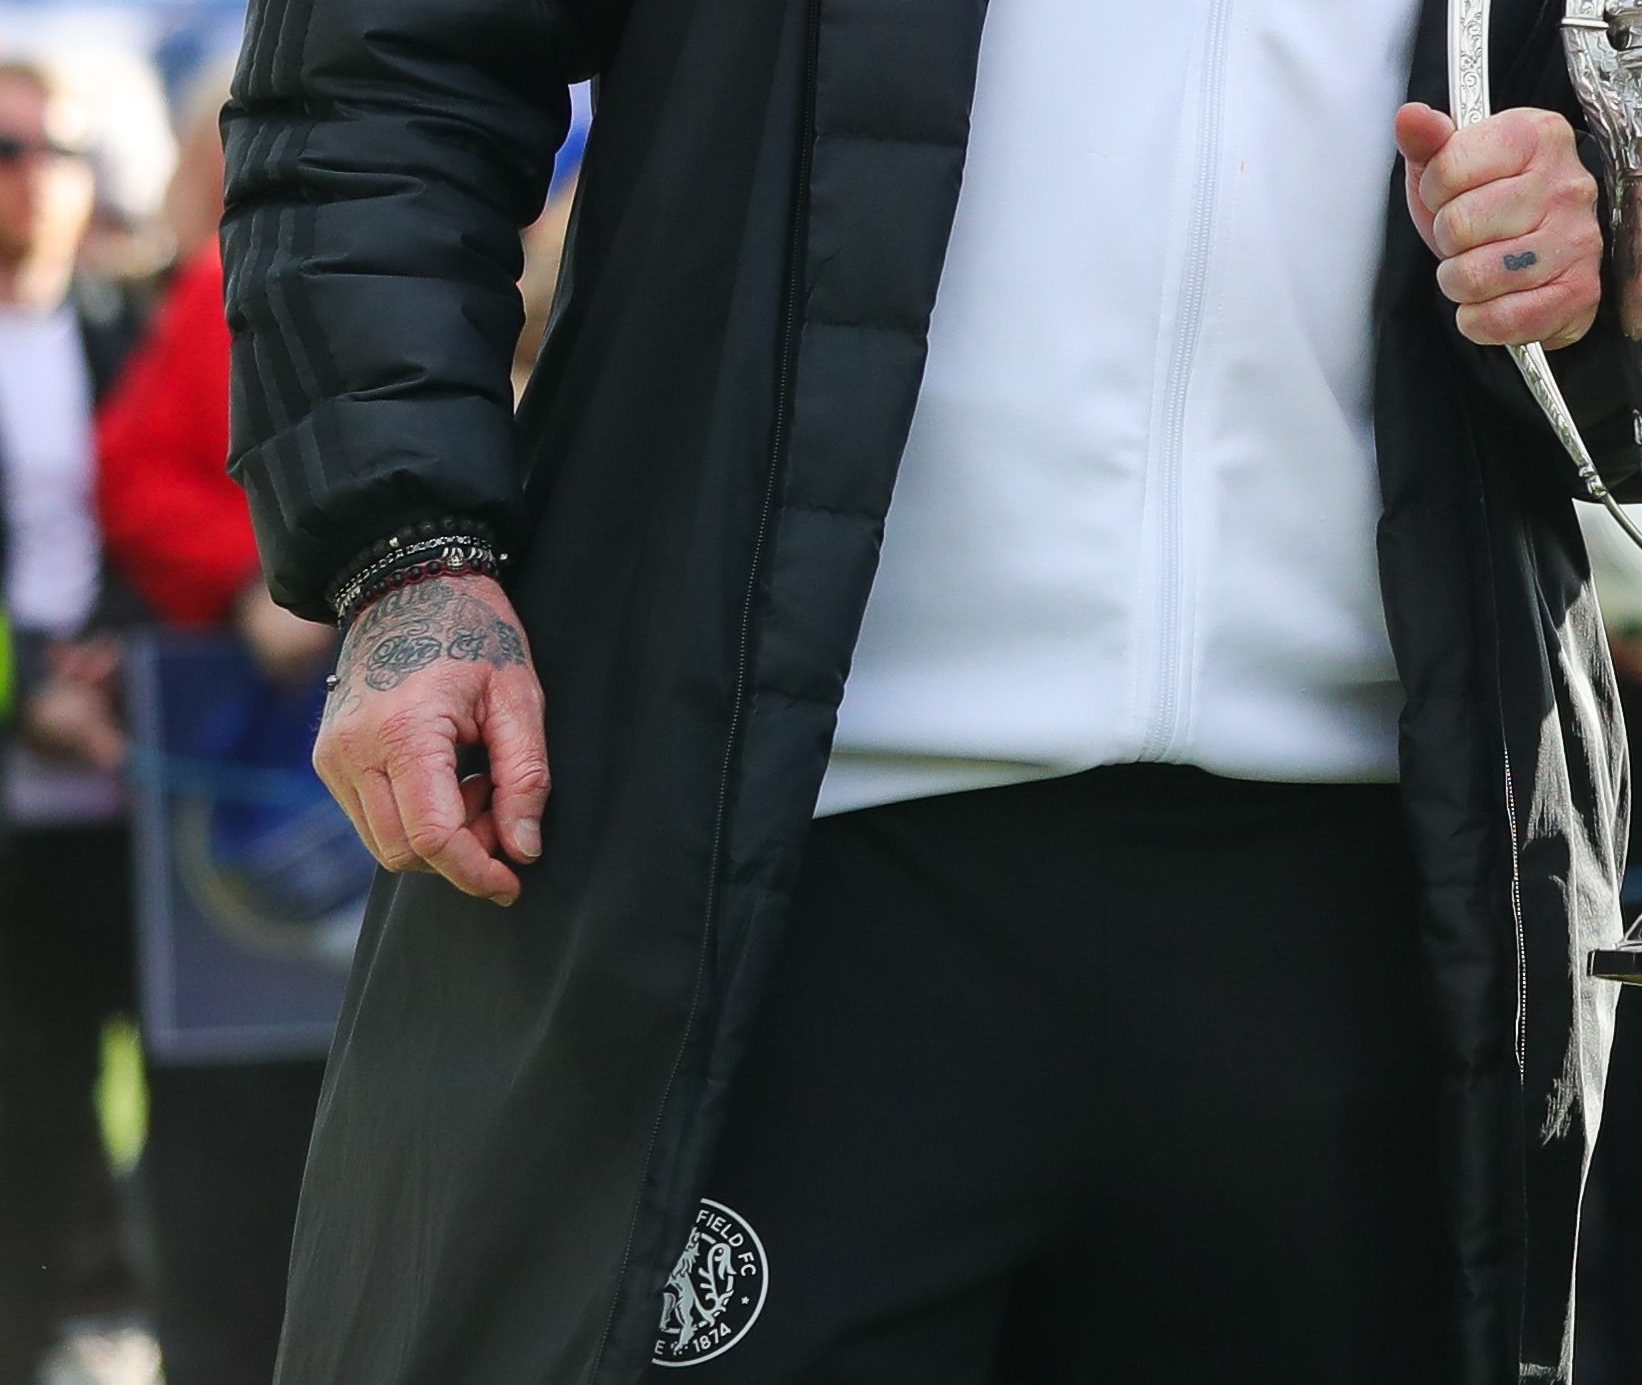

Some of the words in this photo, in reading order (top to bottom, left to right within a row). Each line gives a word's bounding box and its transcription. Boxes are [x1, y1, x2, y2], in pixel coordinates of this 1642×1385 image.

[696, 1209, 744, 1247] FIELD
[738, 1251, 757, 1278] FC
[692, 1322, 732, 1353] 1874
